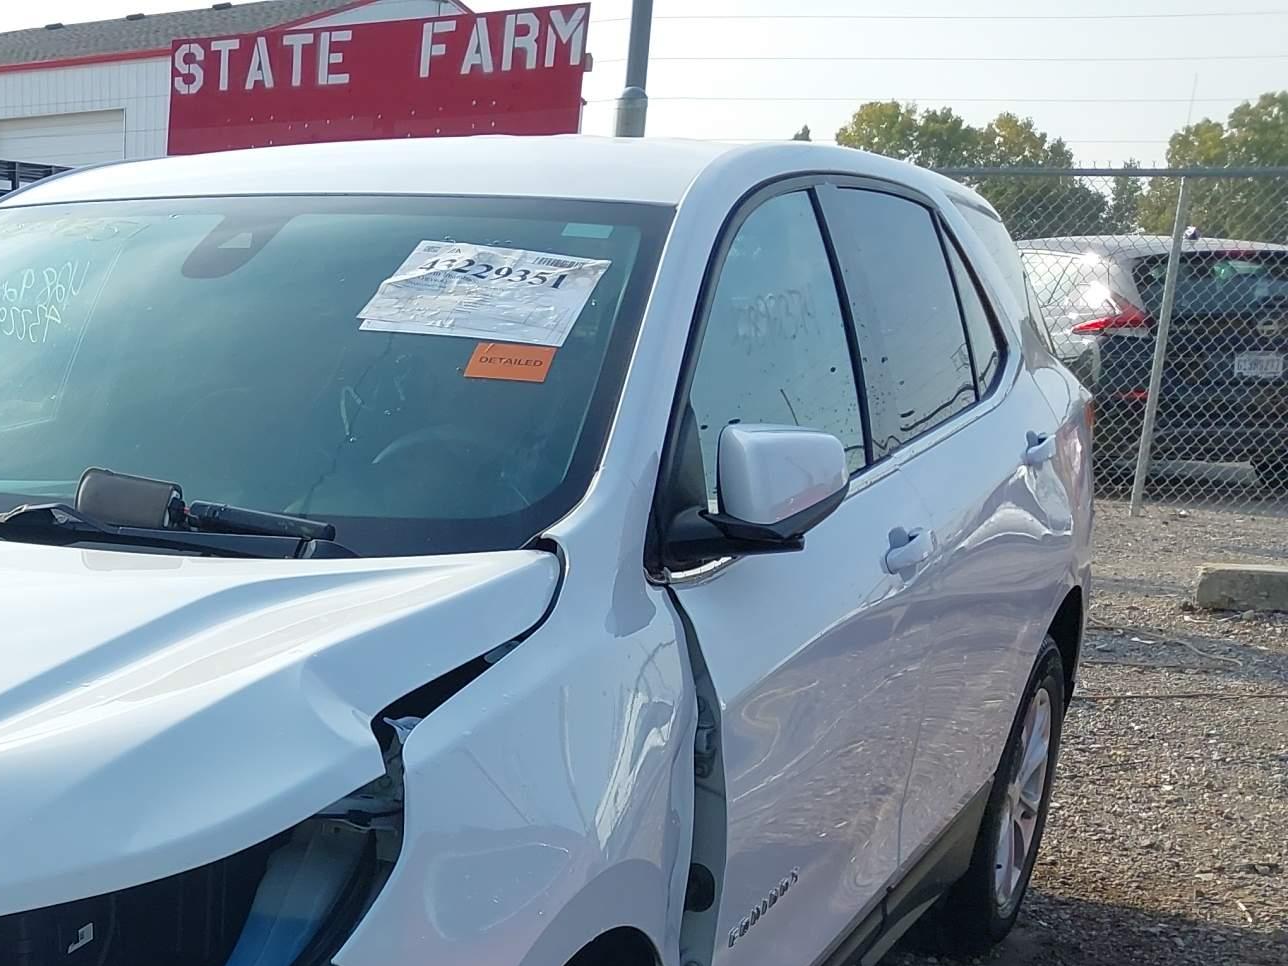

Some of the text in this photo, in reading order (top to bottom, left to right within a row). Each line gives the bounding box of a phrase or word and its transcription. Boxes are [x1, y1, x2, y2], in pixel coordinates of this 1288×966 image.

[174, 7, 587, 95] STATE FARM
[418, 258, 568, 290] 43229351
[479, 355, 544, 368] DETAILED
